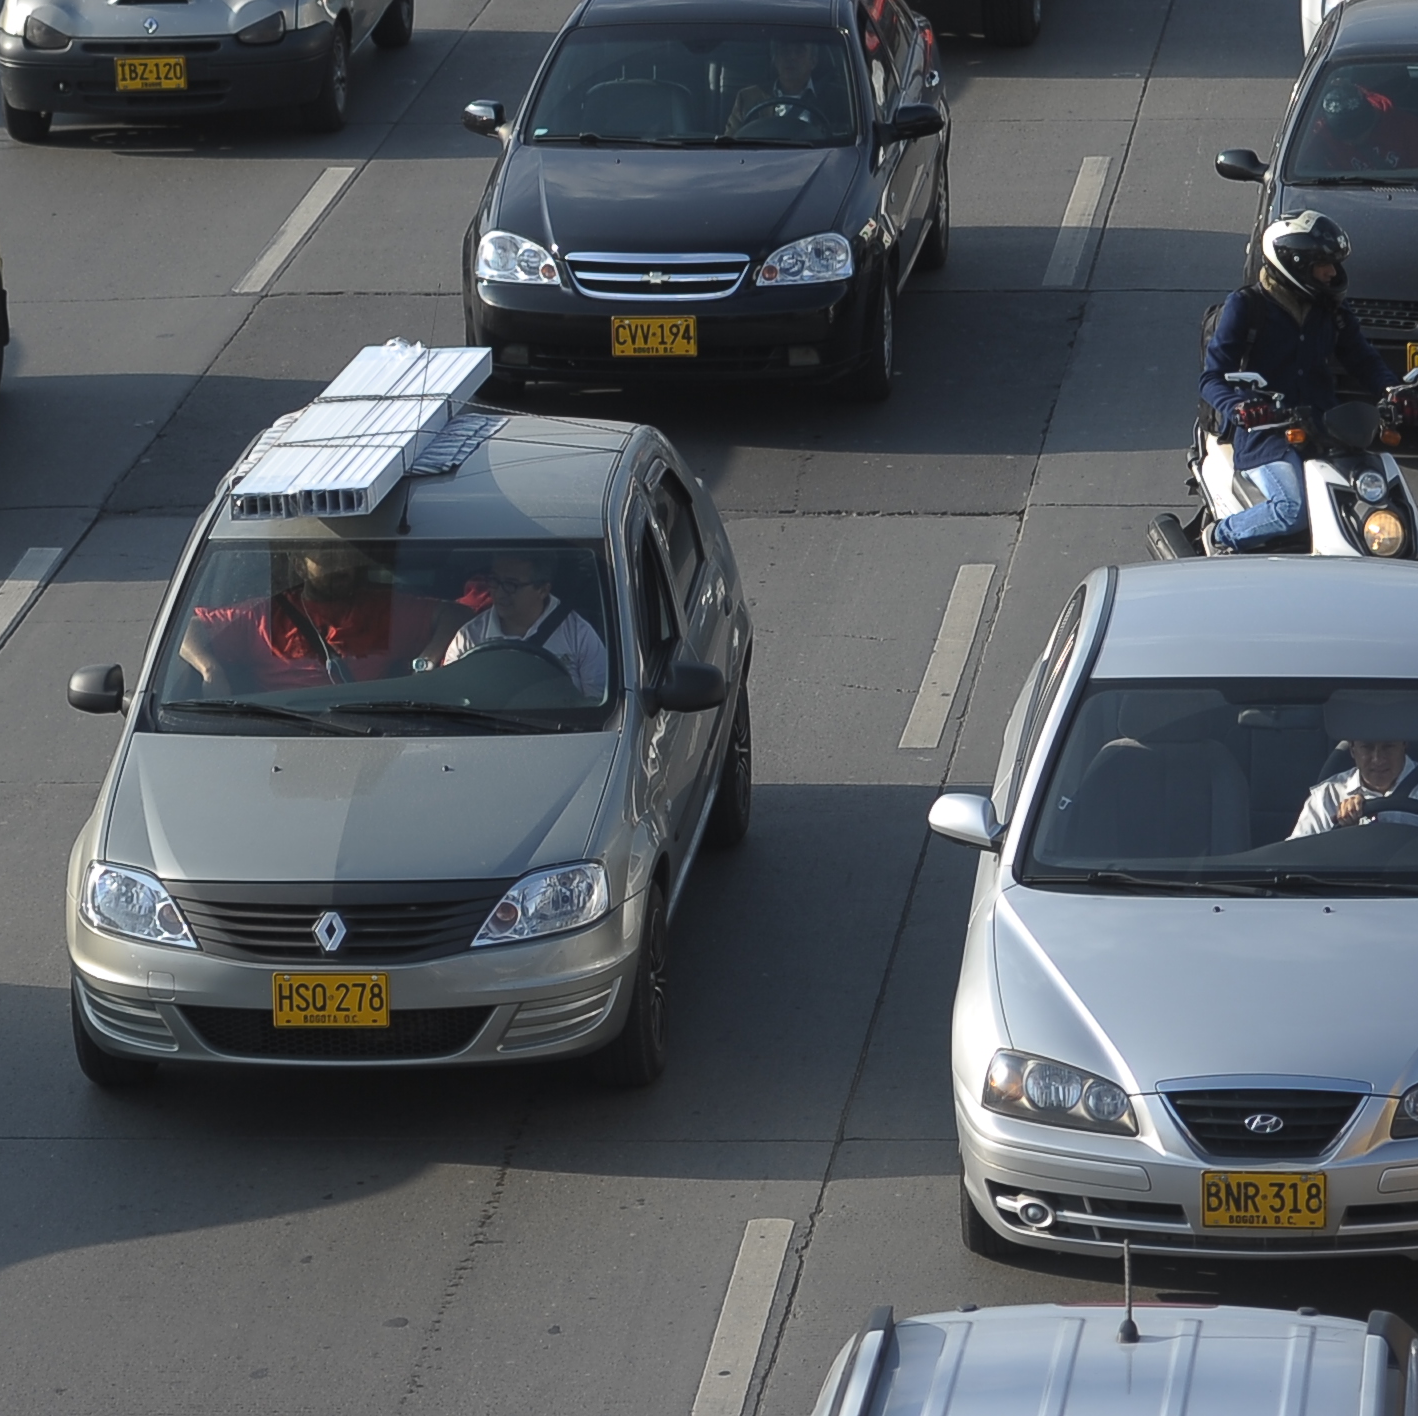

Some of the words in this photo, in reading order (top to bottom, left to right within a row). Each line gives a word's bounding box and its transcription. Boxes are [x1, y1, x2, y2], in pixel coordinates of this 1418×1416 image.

[118, 62, 184, 83] IBZ-120
[615, 324, 694, 347] CVV-194
[303, 1014, 338, 1024] BOGOTA
[1205, 1181, 1323, 1214] BNR-318
[1227, 1215, 1268, 1225] BOGOTA
